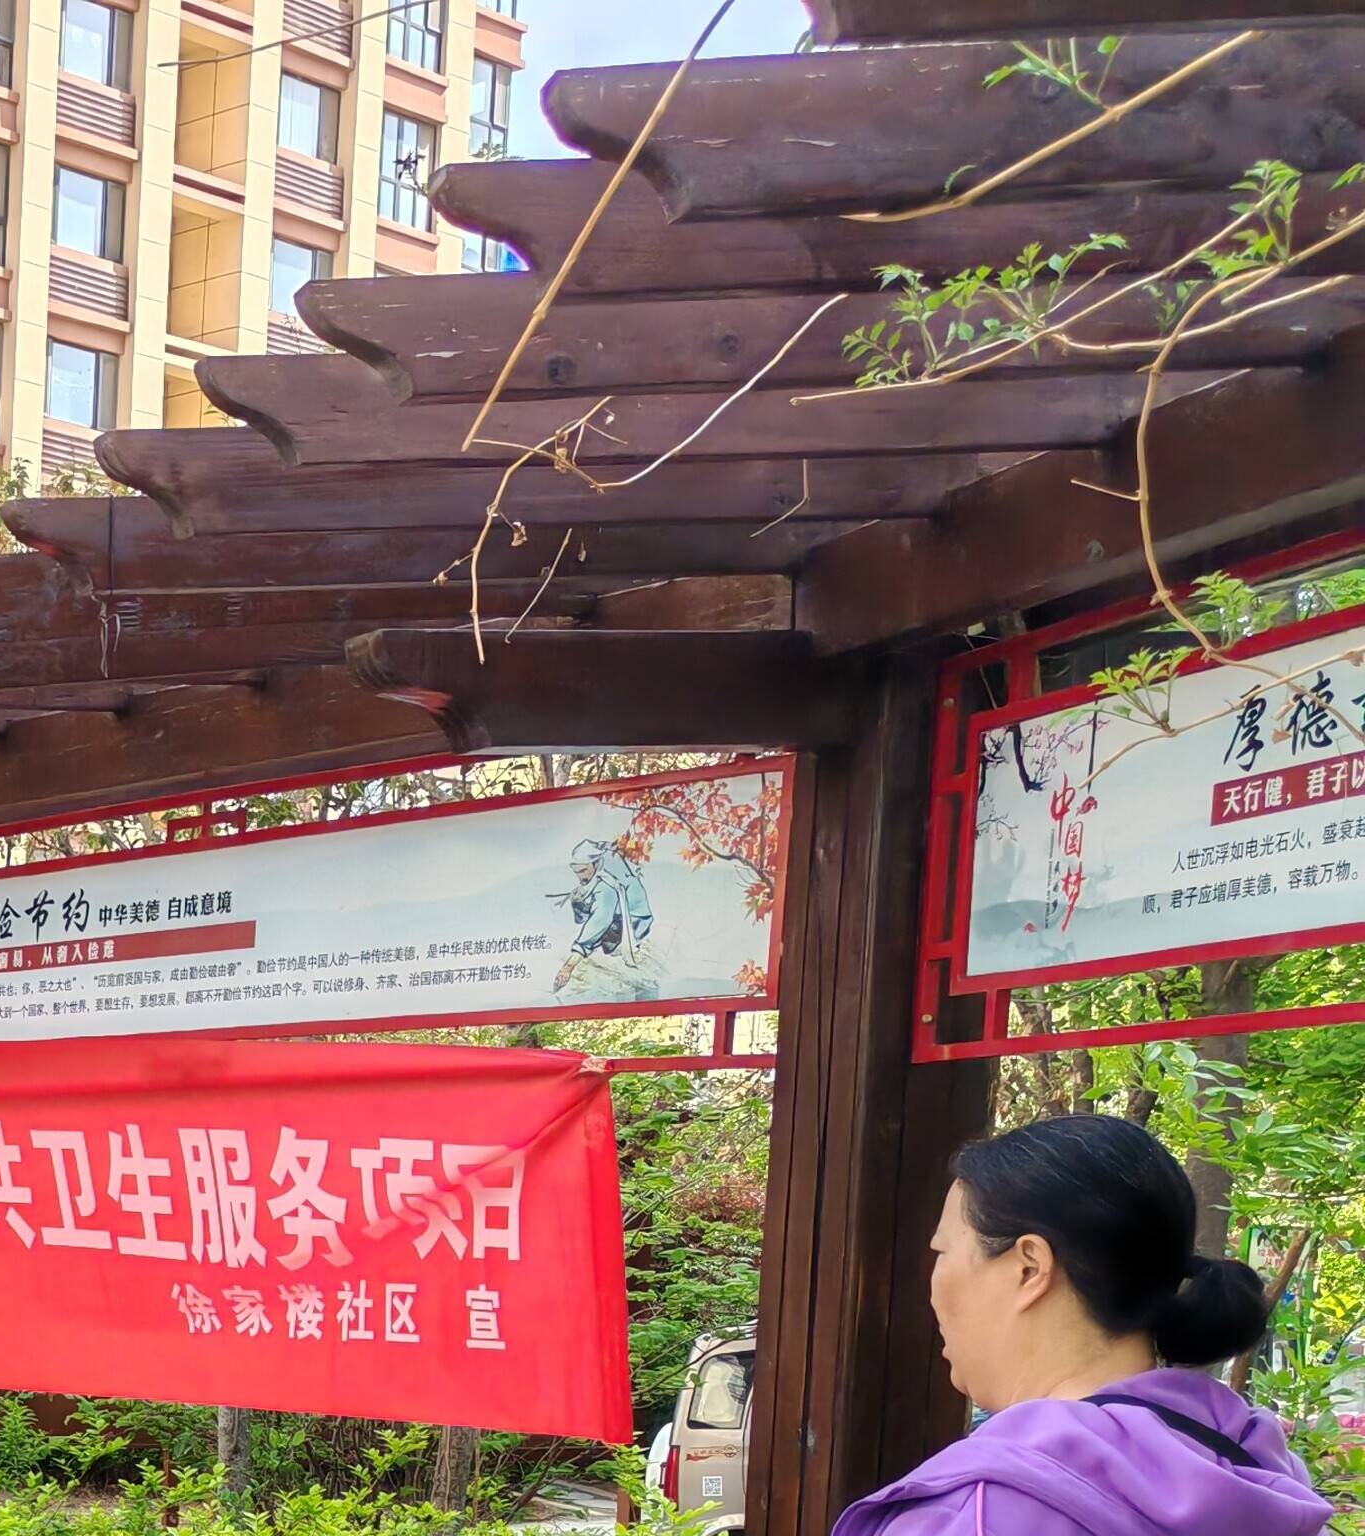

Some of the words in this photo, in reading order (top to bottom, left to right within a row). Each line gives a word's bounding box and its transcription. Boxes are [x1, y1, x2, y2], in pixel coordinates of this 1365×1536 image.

[1050, 770, 1087, 932] 中国梦
[99, 899, 161, 928] 中华美德
[167, 889, 233, 921] 自成意境
[171, 1278, 422, 1345] 徐家楼社区
[465, 1284, 507, 1350] 宣
